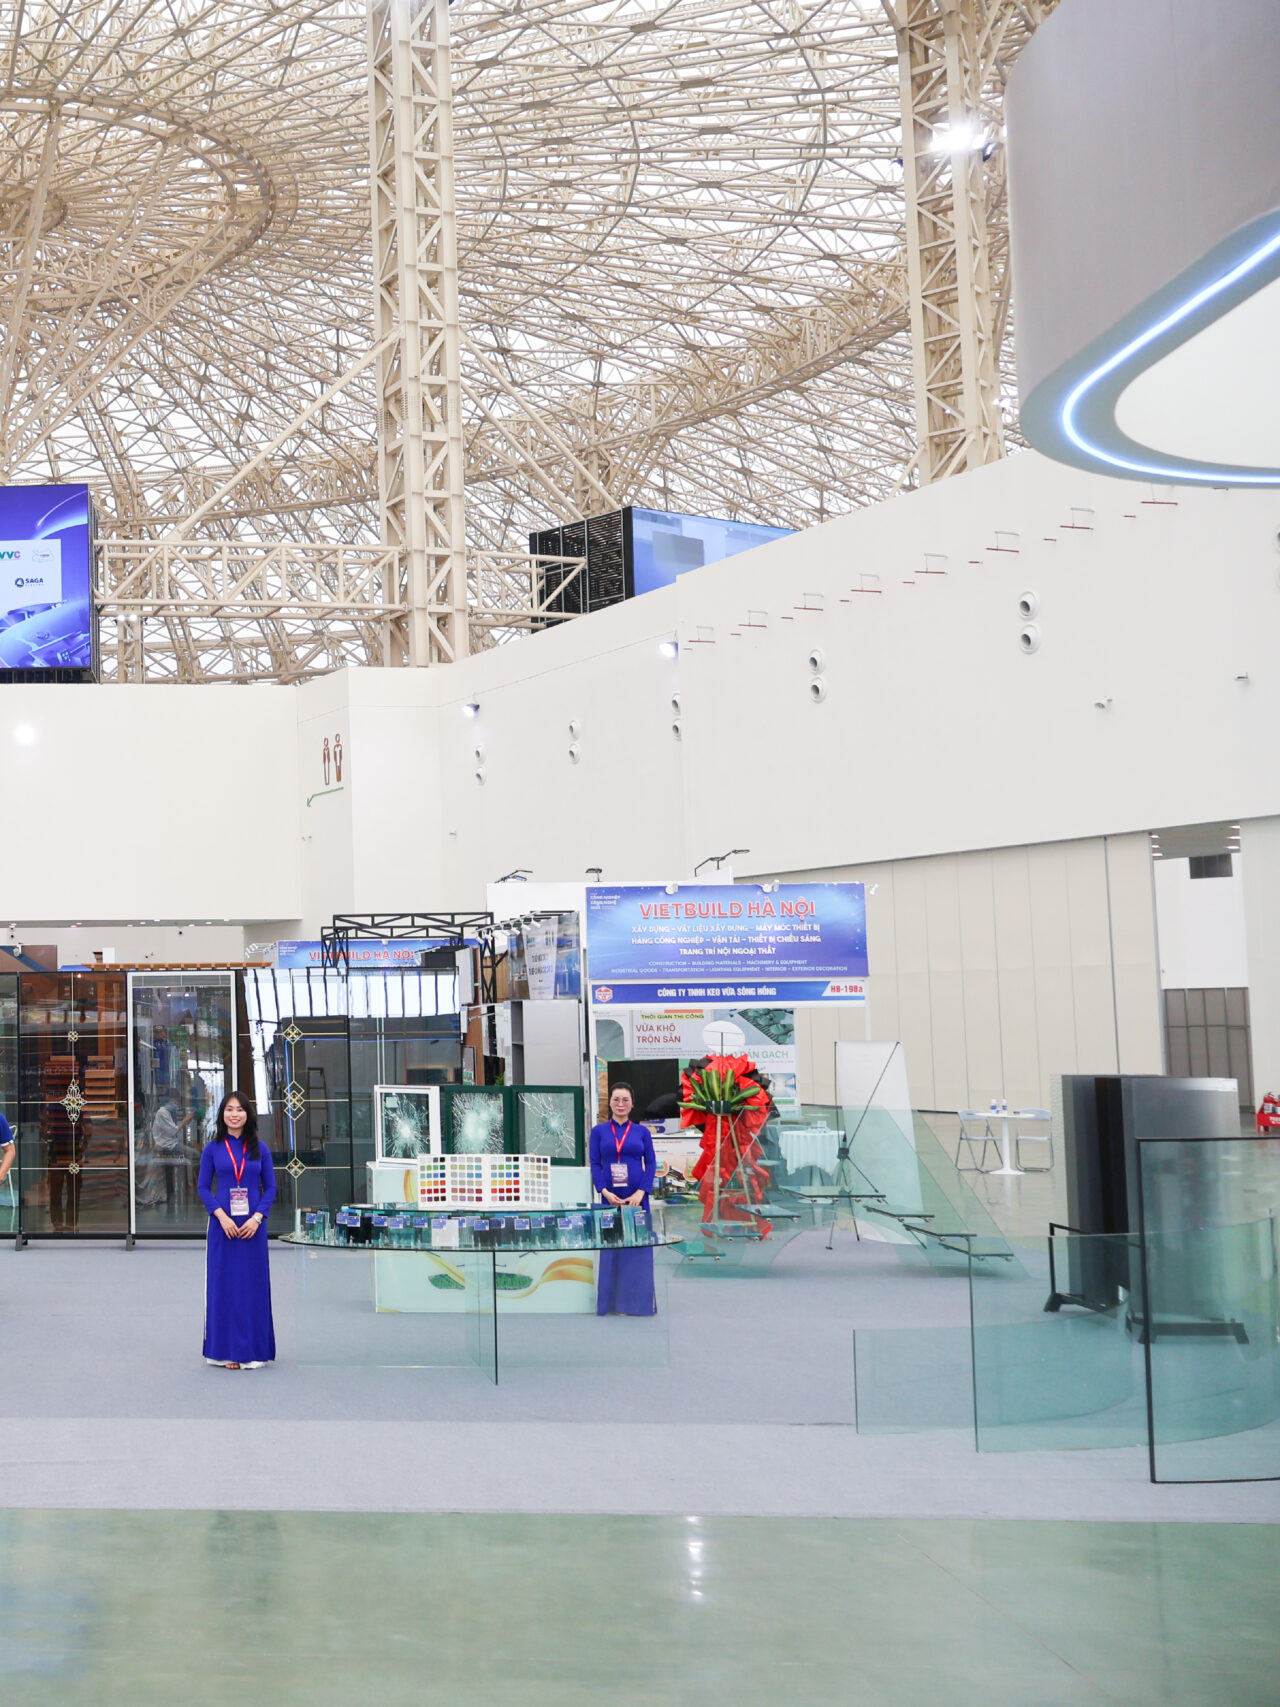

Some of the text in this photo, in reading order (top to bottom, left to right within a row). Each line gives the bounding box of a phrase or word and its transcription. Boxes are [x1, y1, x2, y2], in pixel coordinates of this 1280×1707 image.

[639, 896, 815, 921] VIETBUILD HÀ NỘI
[632, 925, 648, 933] XÂY
[710, 924, 726, 932] XÂY
[793, 921, 812, 931] THIẾT
[632, 936, 653, 945] HÀNG
[654, 936, 676, 944] CÔNG
[677, 936, 704, 946] NGHIỆP
[712, 936, 727, 945] VẬN
[800, 934, 821, 943] SÁNG
[373, 948, 390, 960] HÀ
[679, 948, 703, 956] TRANG
[717, 947, 731, 956] NỘI
[732, 947, 756, 956] NGOẠI
[758, 945, 776, 955] THẤT
[657, 987, 676, 997] CÔNG
[677, 989, 686, 997] TY
[688, 988, 706, 997] TNHH
[707, 988, 720, 997] KEO
[721, 986, 735, 997] VỮA
[737, 987, 756, 996] SÔNG
[831, 985, 863, 994] HB-198a
[636, 1022, 676, 1032] VỮA KHÔ
[636, 1034, 660, 1045] TRỘN
